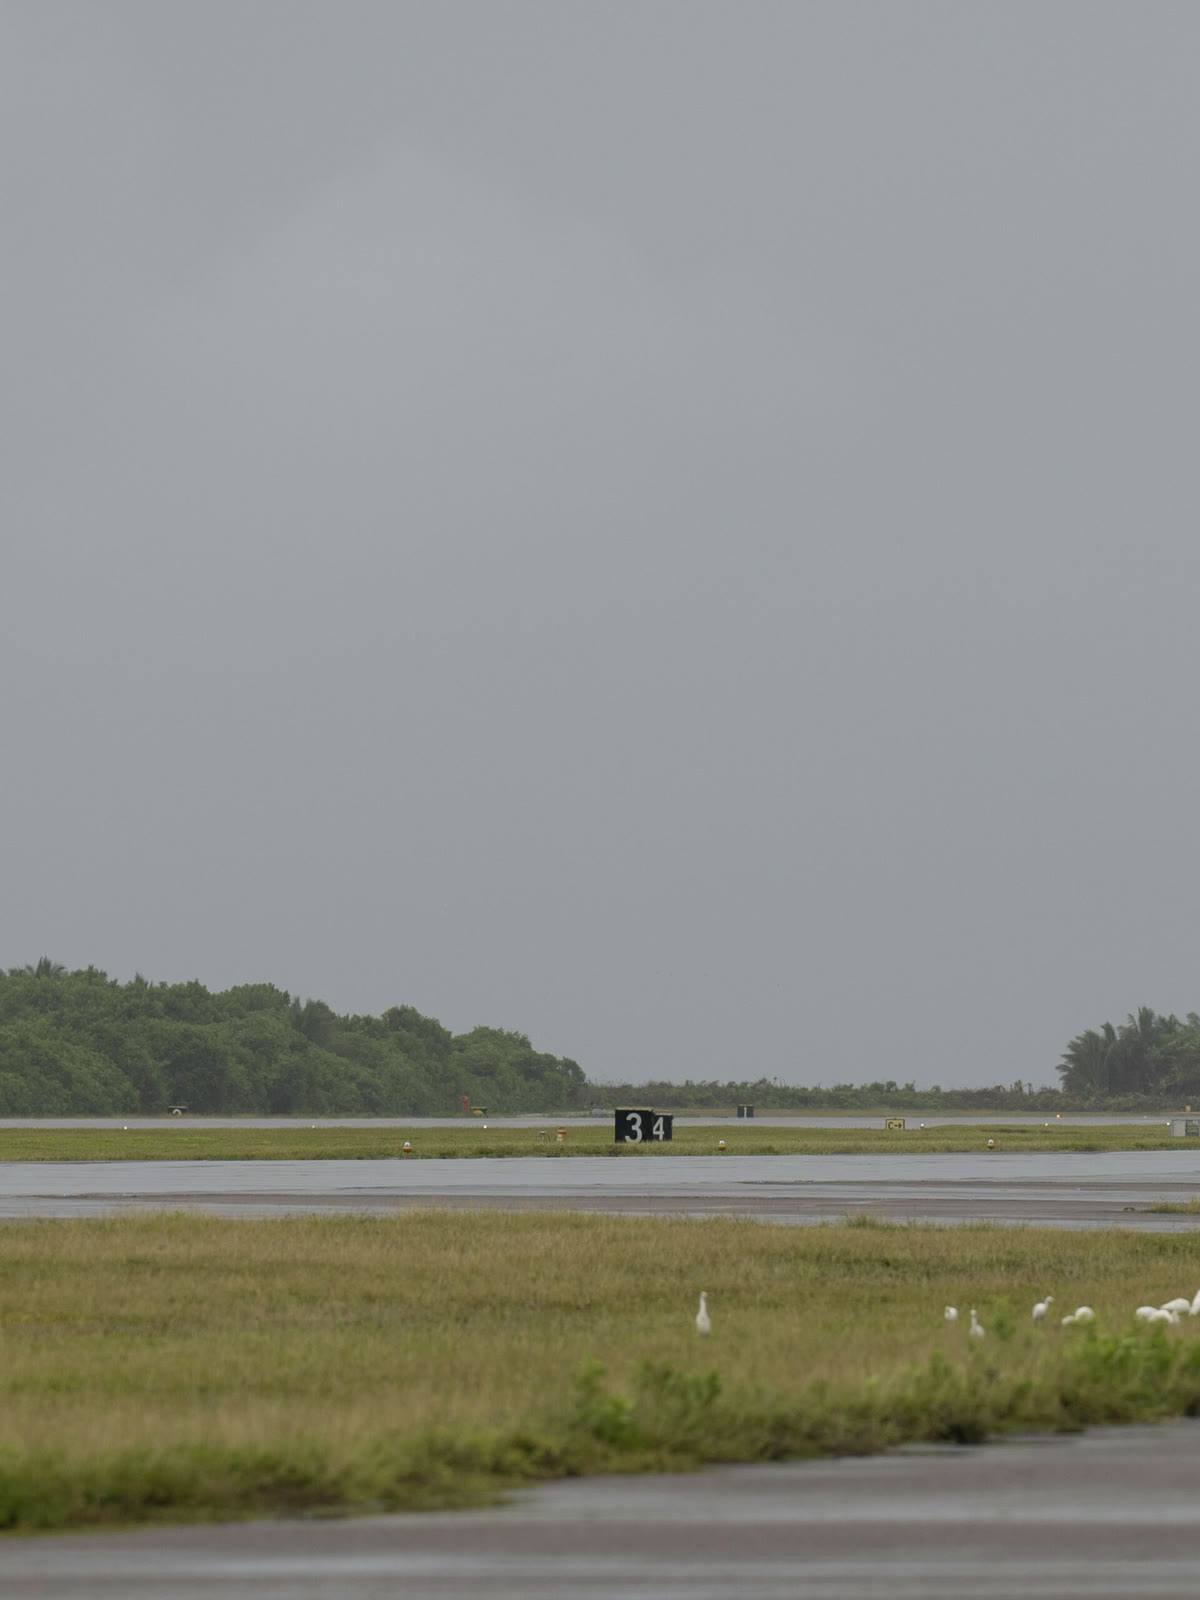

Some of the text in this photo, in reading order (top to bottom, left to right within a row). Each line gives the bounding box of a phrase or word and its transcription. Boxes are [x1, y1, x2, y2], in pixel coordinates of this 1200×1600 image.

[624, 1112, 643, 1143] 3
[652, 1117, 665, 1141] 4
[888, 1121, 895, 1130] C
